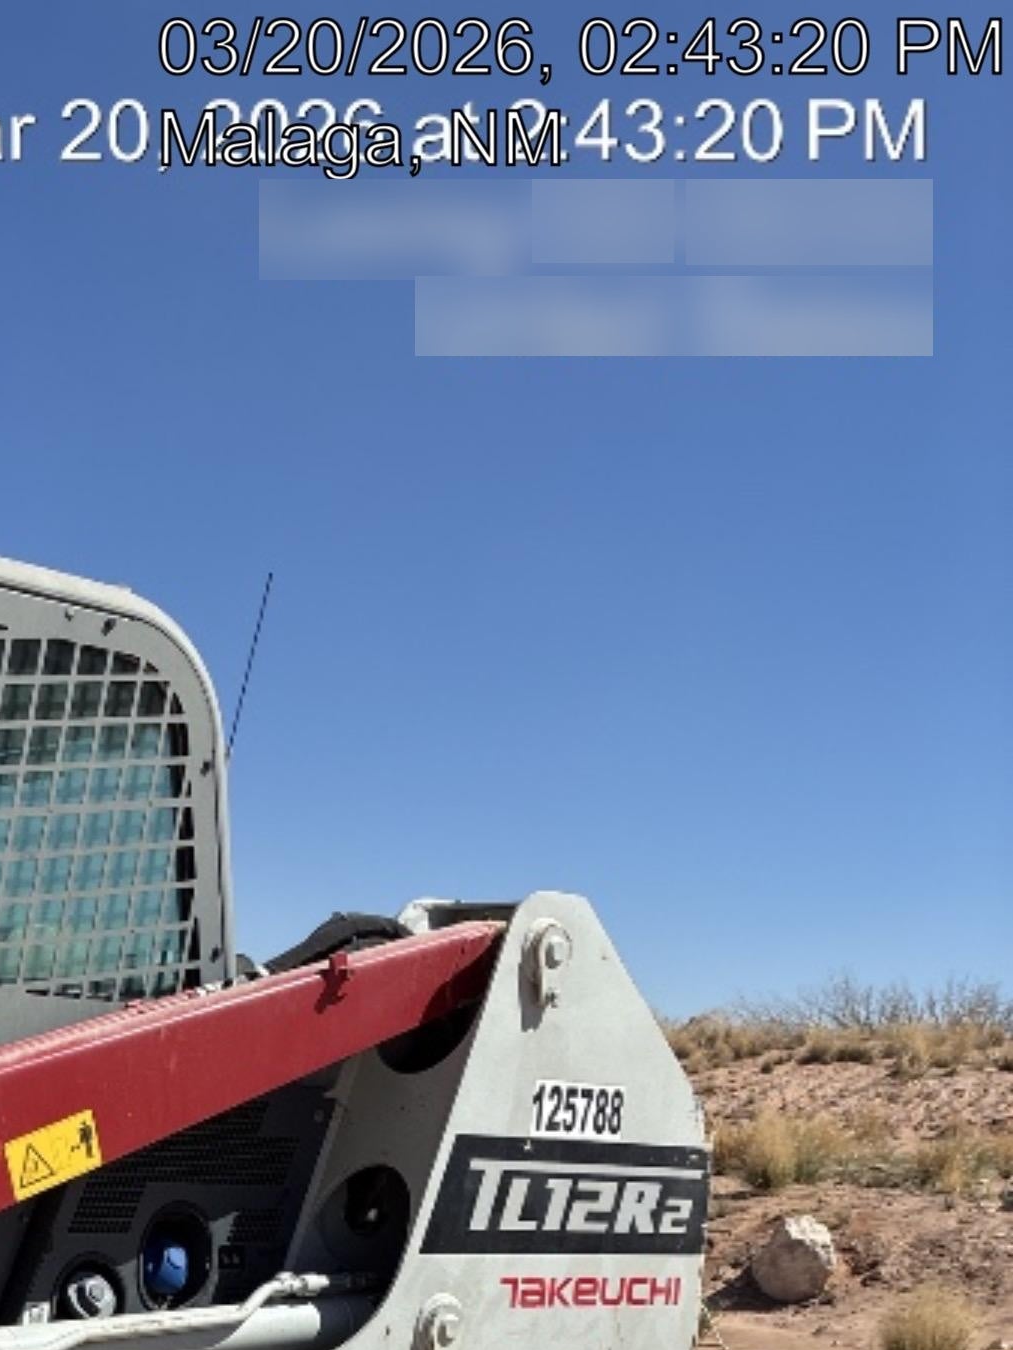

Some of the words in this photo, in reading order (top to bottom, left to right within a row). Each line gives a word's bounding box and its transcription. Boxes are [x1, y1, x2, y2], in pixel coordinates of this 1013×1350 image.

[532, 1083, 624, 1135] 125788
[468, 1158, 705, 1235] TL12R2
[499, 1276, 682, 1309] TAKEUCHI
